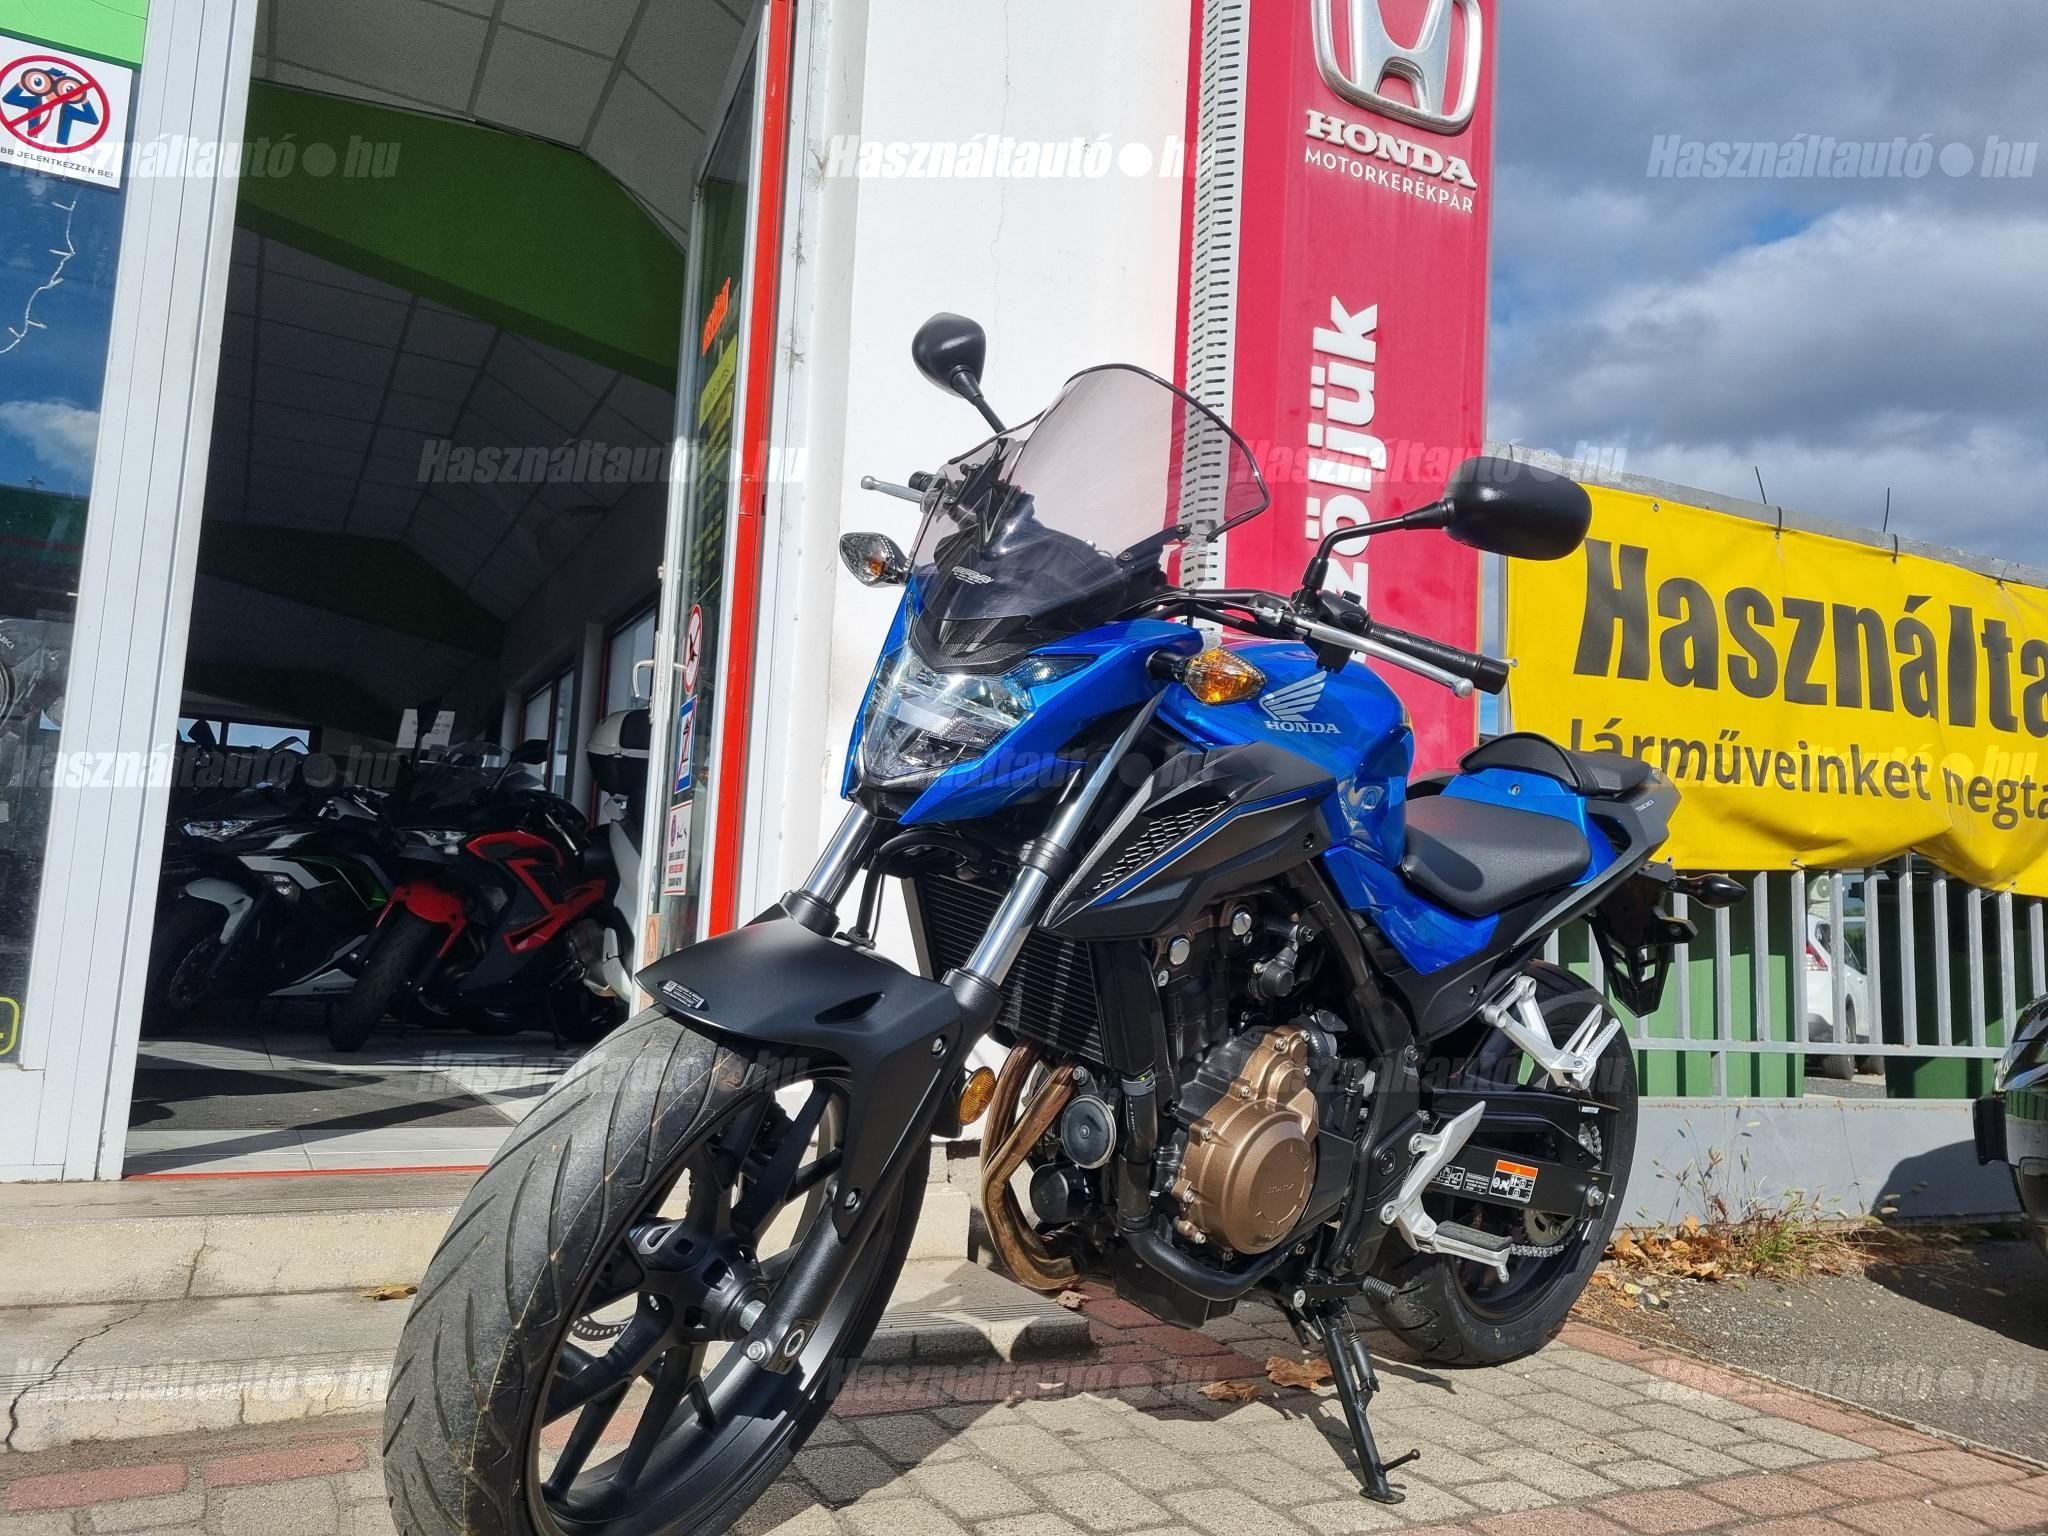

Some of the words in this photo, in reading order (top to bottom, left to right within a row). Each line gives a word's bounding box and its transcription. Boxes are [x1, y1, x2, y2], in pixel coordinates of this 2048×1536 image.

[16, 150, 95, 174] JELENTKEZZEN
[97, 169, 114, 179] BE!
[1305, 109, 1478, 189] HONDA
[1305, 146, 1474, 214] MOTORKERÉKPÁR
[1305, 295, 1388, 665] zöljük
[1264, 720, 1342, 734] HONDA
